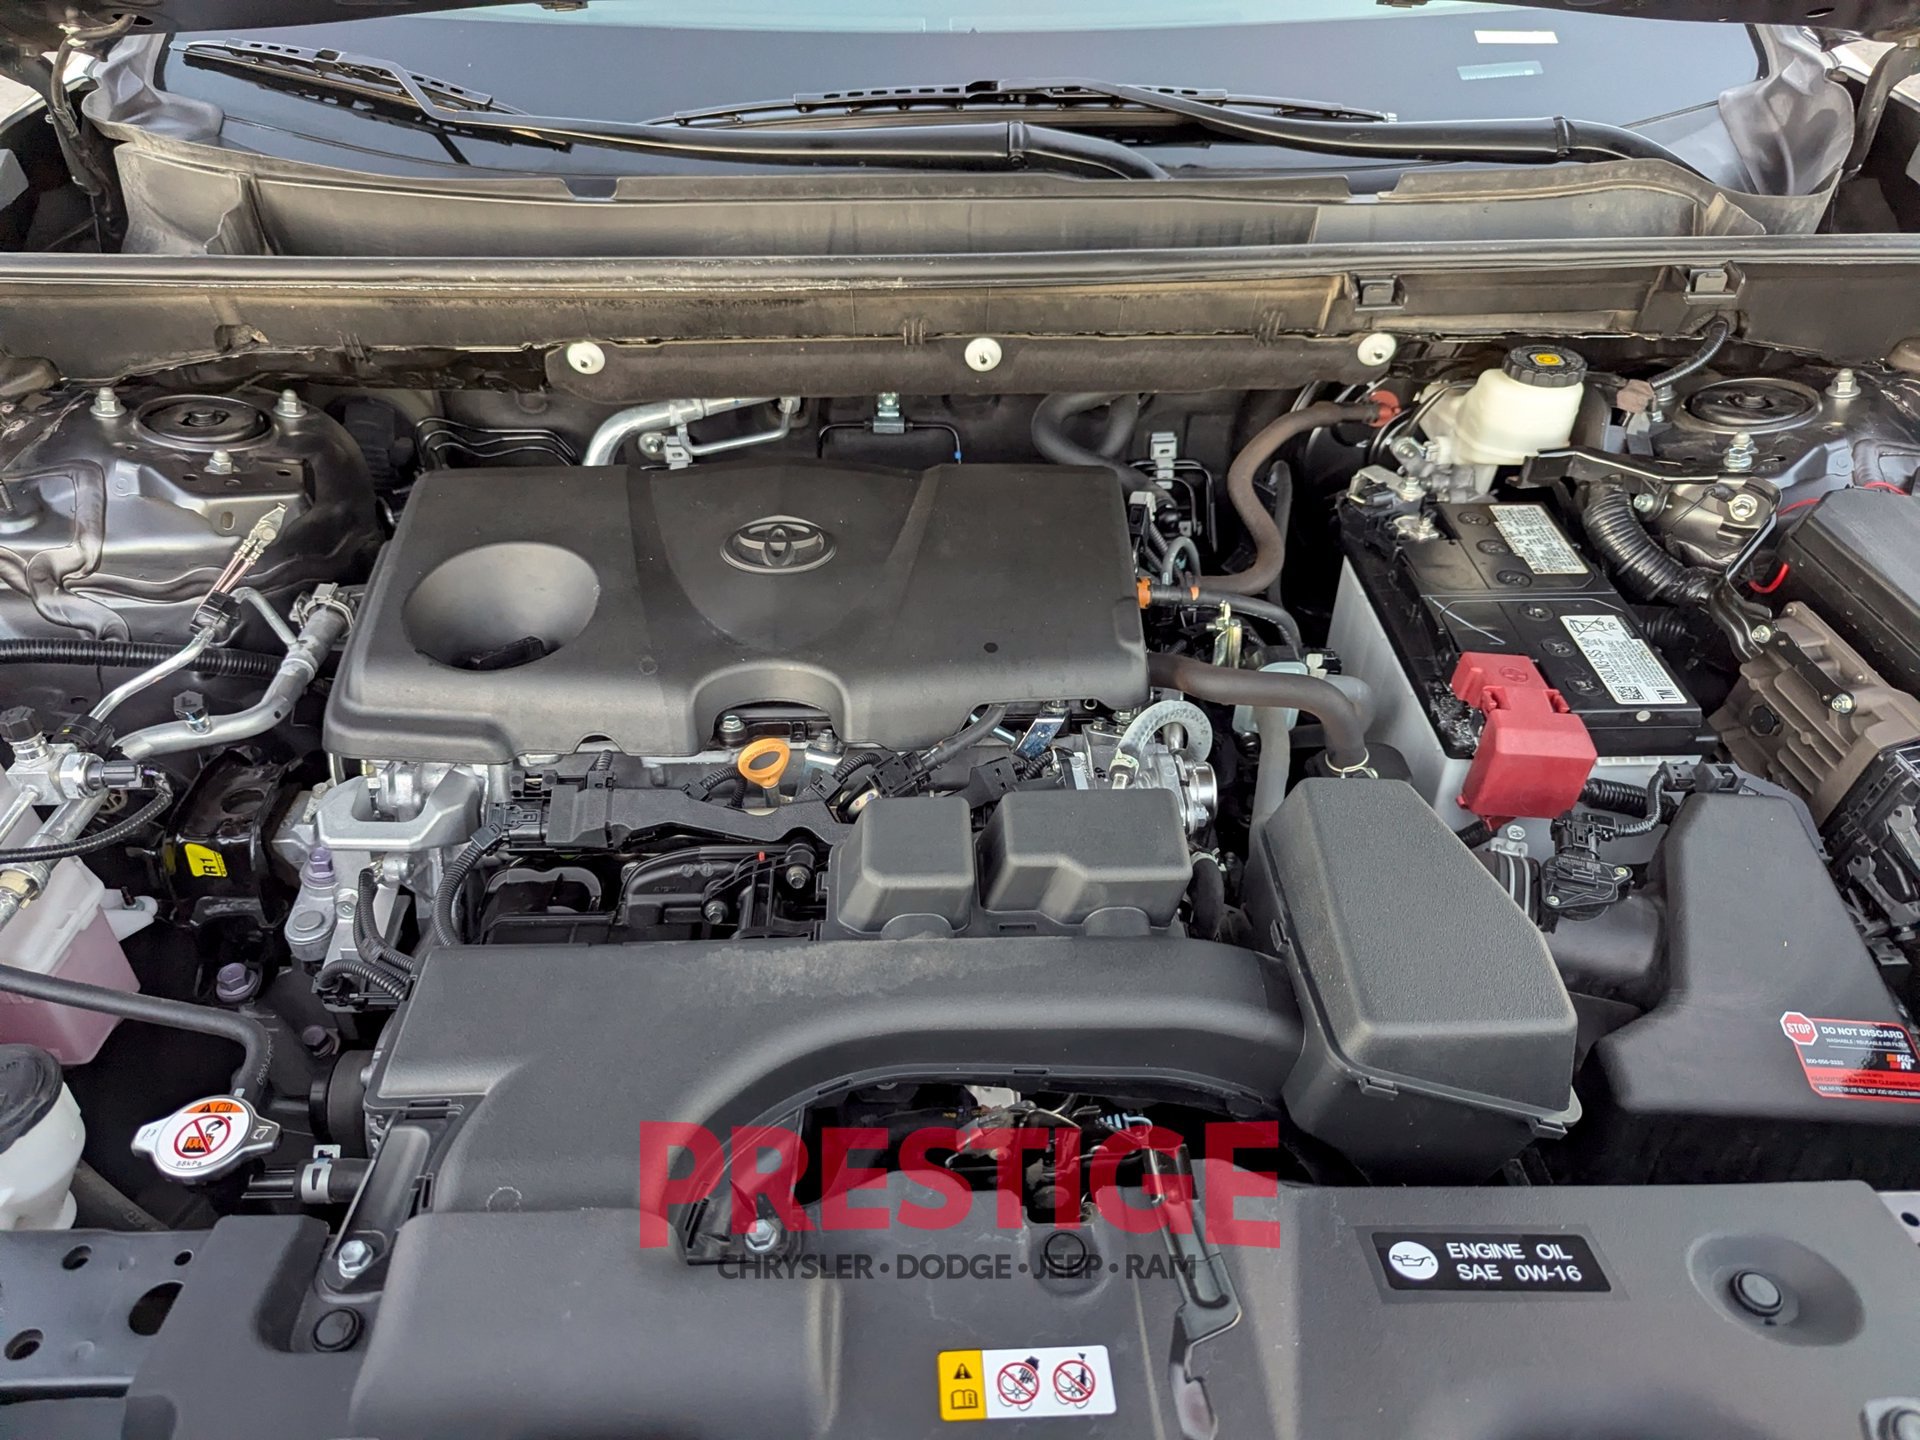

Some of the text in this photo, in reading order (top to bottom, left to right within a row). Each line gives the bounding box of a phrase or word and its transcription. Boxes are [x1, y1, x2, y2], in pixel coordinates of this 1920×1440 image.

[1656, 689, 1677, 700] TM
[200, 857, 218, 874] R1
[1786, 1023, 1811, 1035] STOP
[1821, 1026, 1904, 1039] DO NOT DISCARD
[1446, 1242, 1573, 1260] ENGINE OIL
[1456, 1264, 1582, 1282] SAE 0W-16
